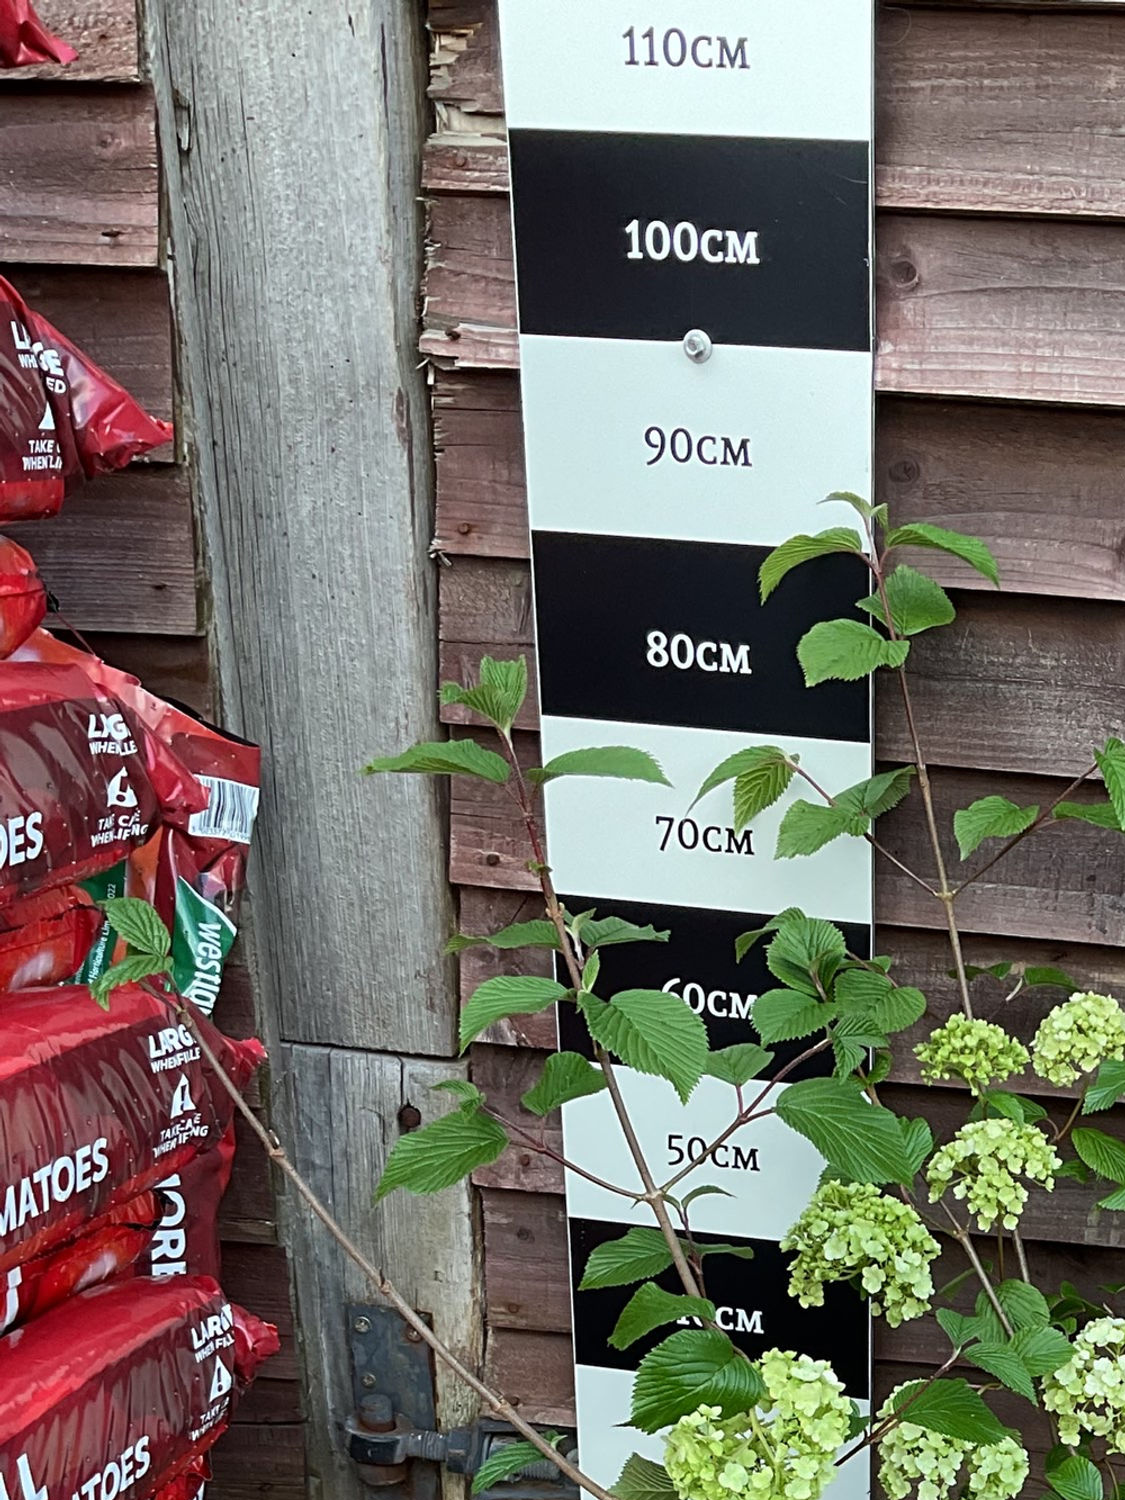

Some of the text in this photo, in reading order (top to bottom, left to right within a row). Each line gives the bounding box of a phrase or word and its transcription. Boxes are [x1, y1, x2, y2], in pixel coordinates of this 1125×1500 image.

[622, 26, 751, 70] 110CM
[625, 219, 761, 265] 100CM
[644, 427, 753, 468] 90CM
[646, 631, 752, 675] 80CM
[655, 816, 755, 856] 70CM
[106, 883, 117, 899] 022
[189, 922, 223, 1017] westla
[148, 1024, 197, 1059] LARG
[668, 1134, 760, 1172] 50CM
